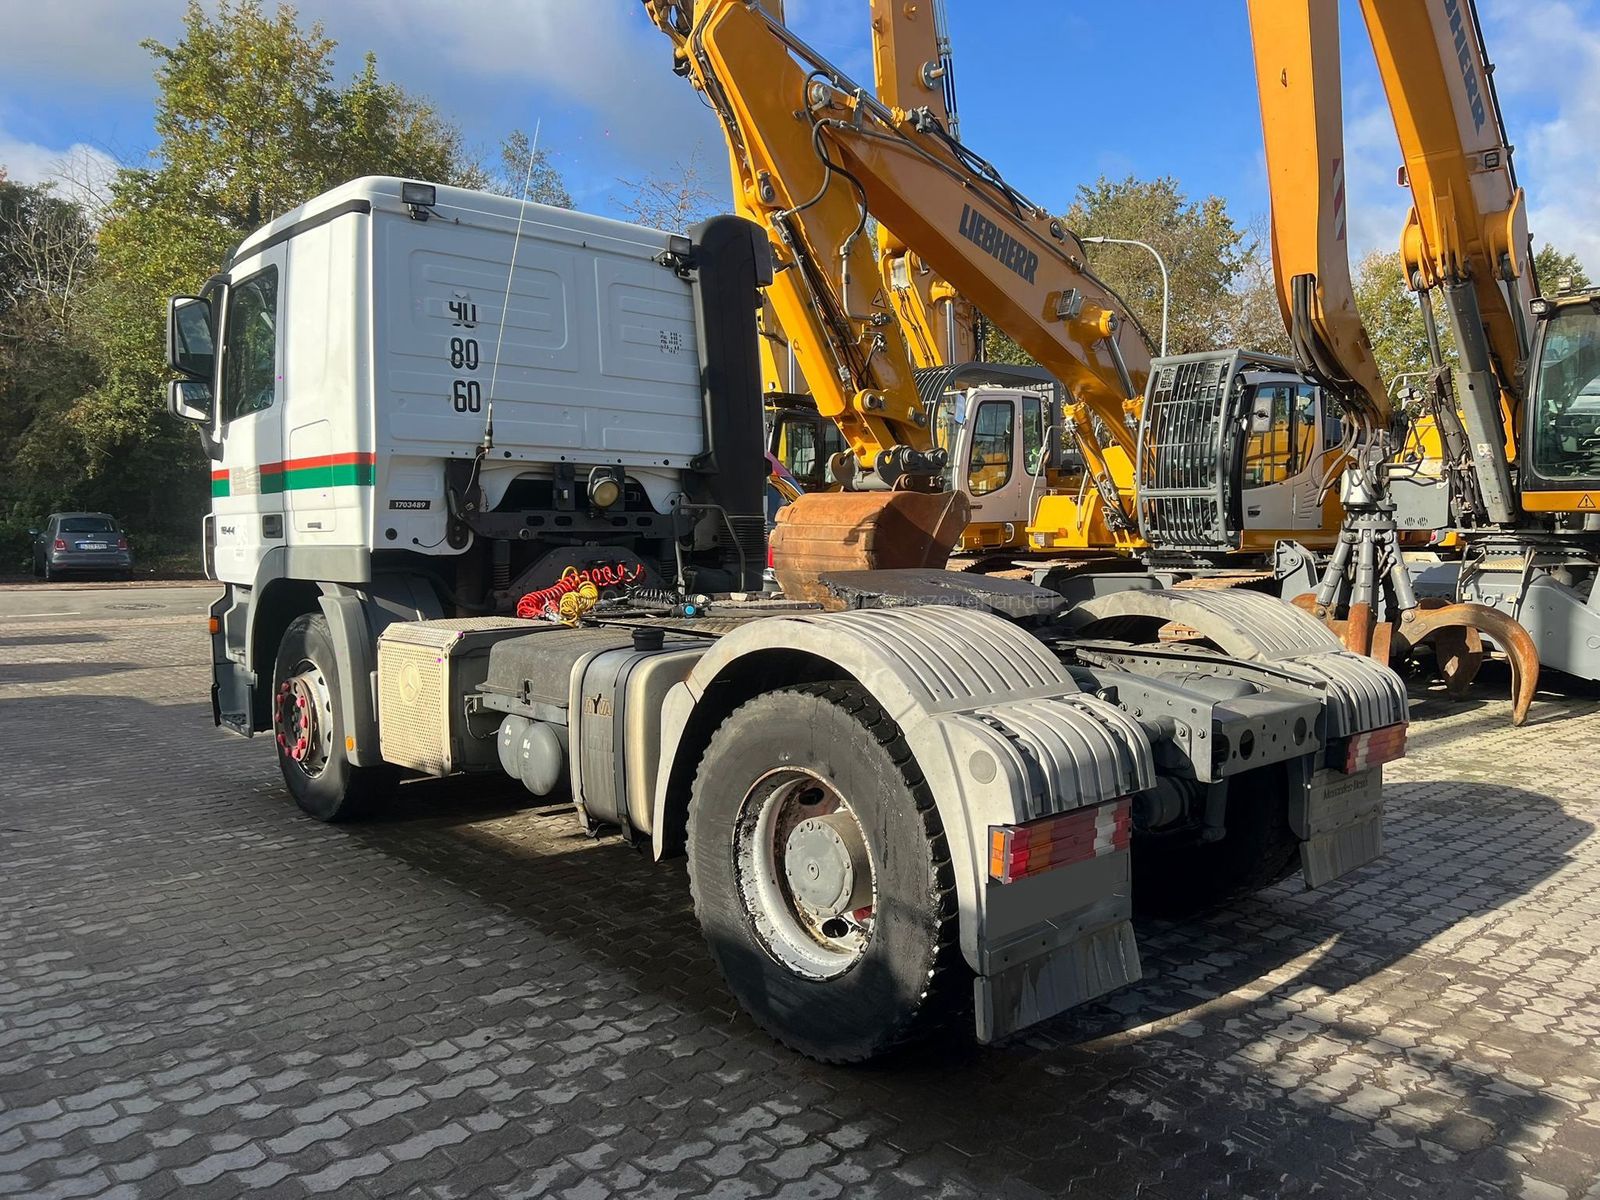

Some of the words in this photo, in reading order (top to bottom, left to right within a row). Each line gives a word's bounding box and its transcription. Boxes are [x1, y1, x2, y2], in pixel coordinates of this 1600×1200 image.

[959, 203, 1039, 285] LIEBHERR
[450, 337, 479, 370] 80
[453, 380, 481, 413] 60
[395, 501, 426, 509] 1703489
